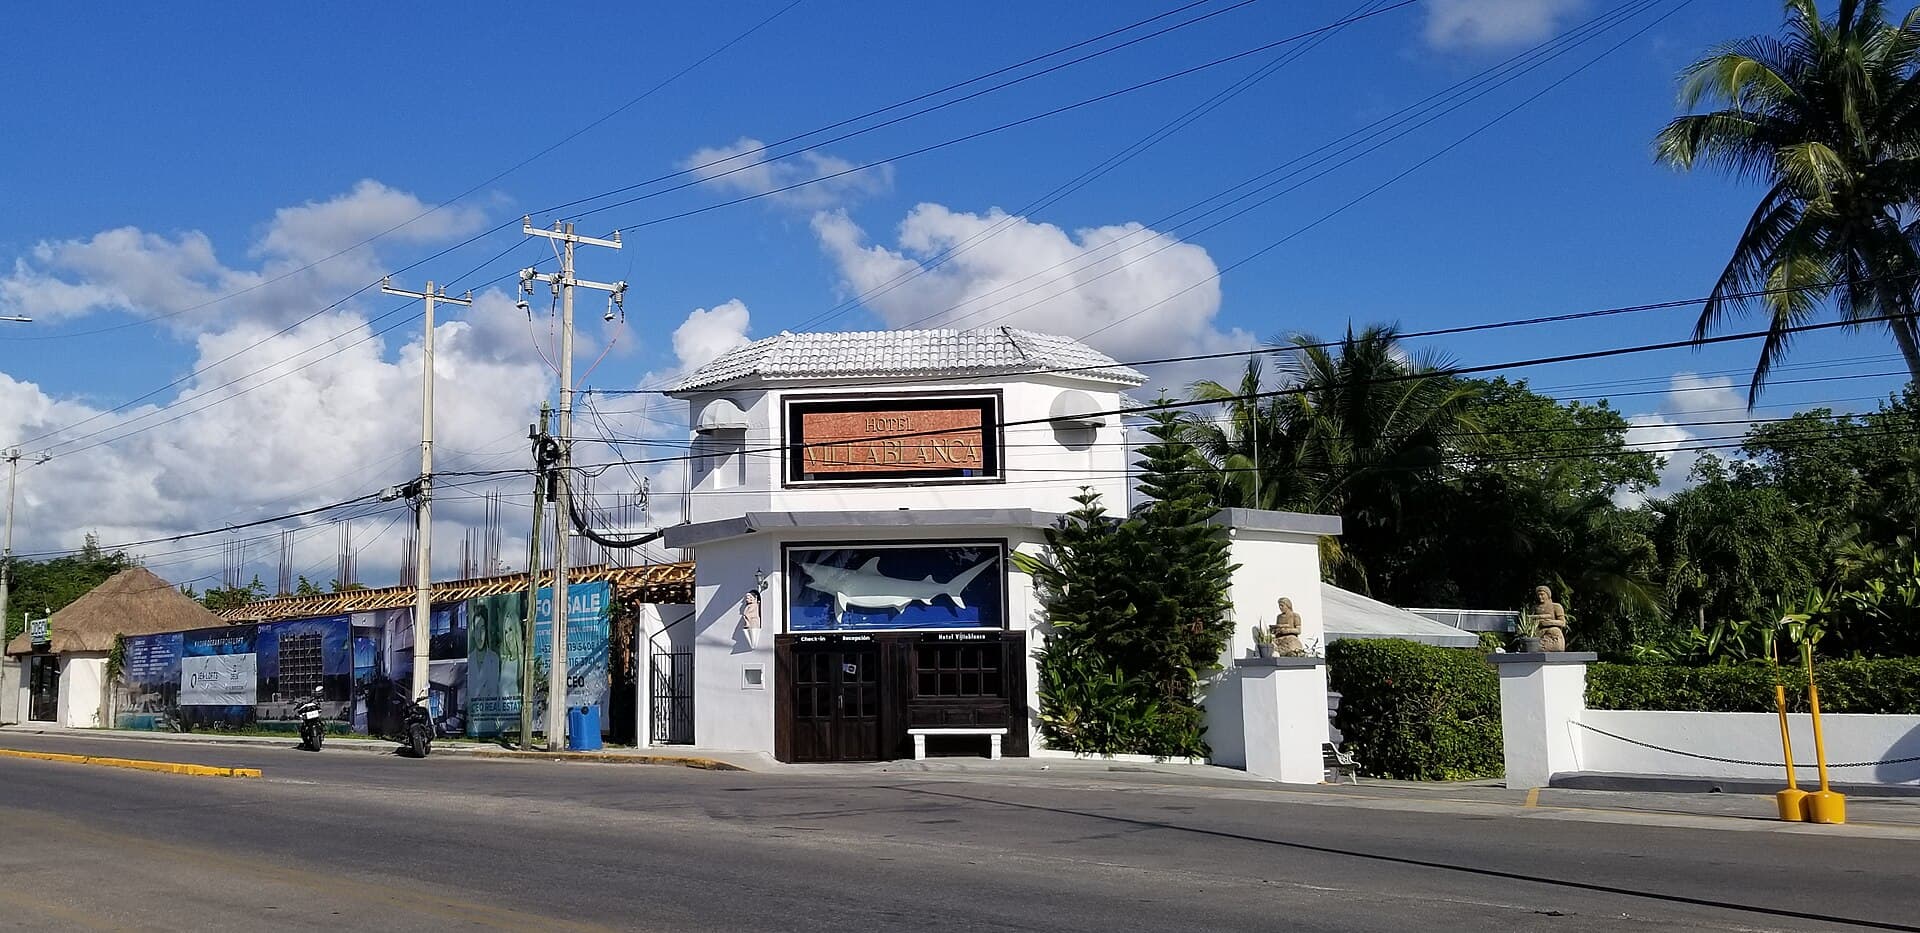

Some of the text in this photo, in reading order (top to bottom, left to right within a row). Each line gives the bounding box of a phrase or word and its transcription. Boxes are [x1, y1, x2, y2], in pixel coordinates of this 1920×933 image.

[865, 416, 916, 433] HOTEL
[804, 438, 981, 467] VILLABLANCA
[502, 701, 521, 711] ESTAT
